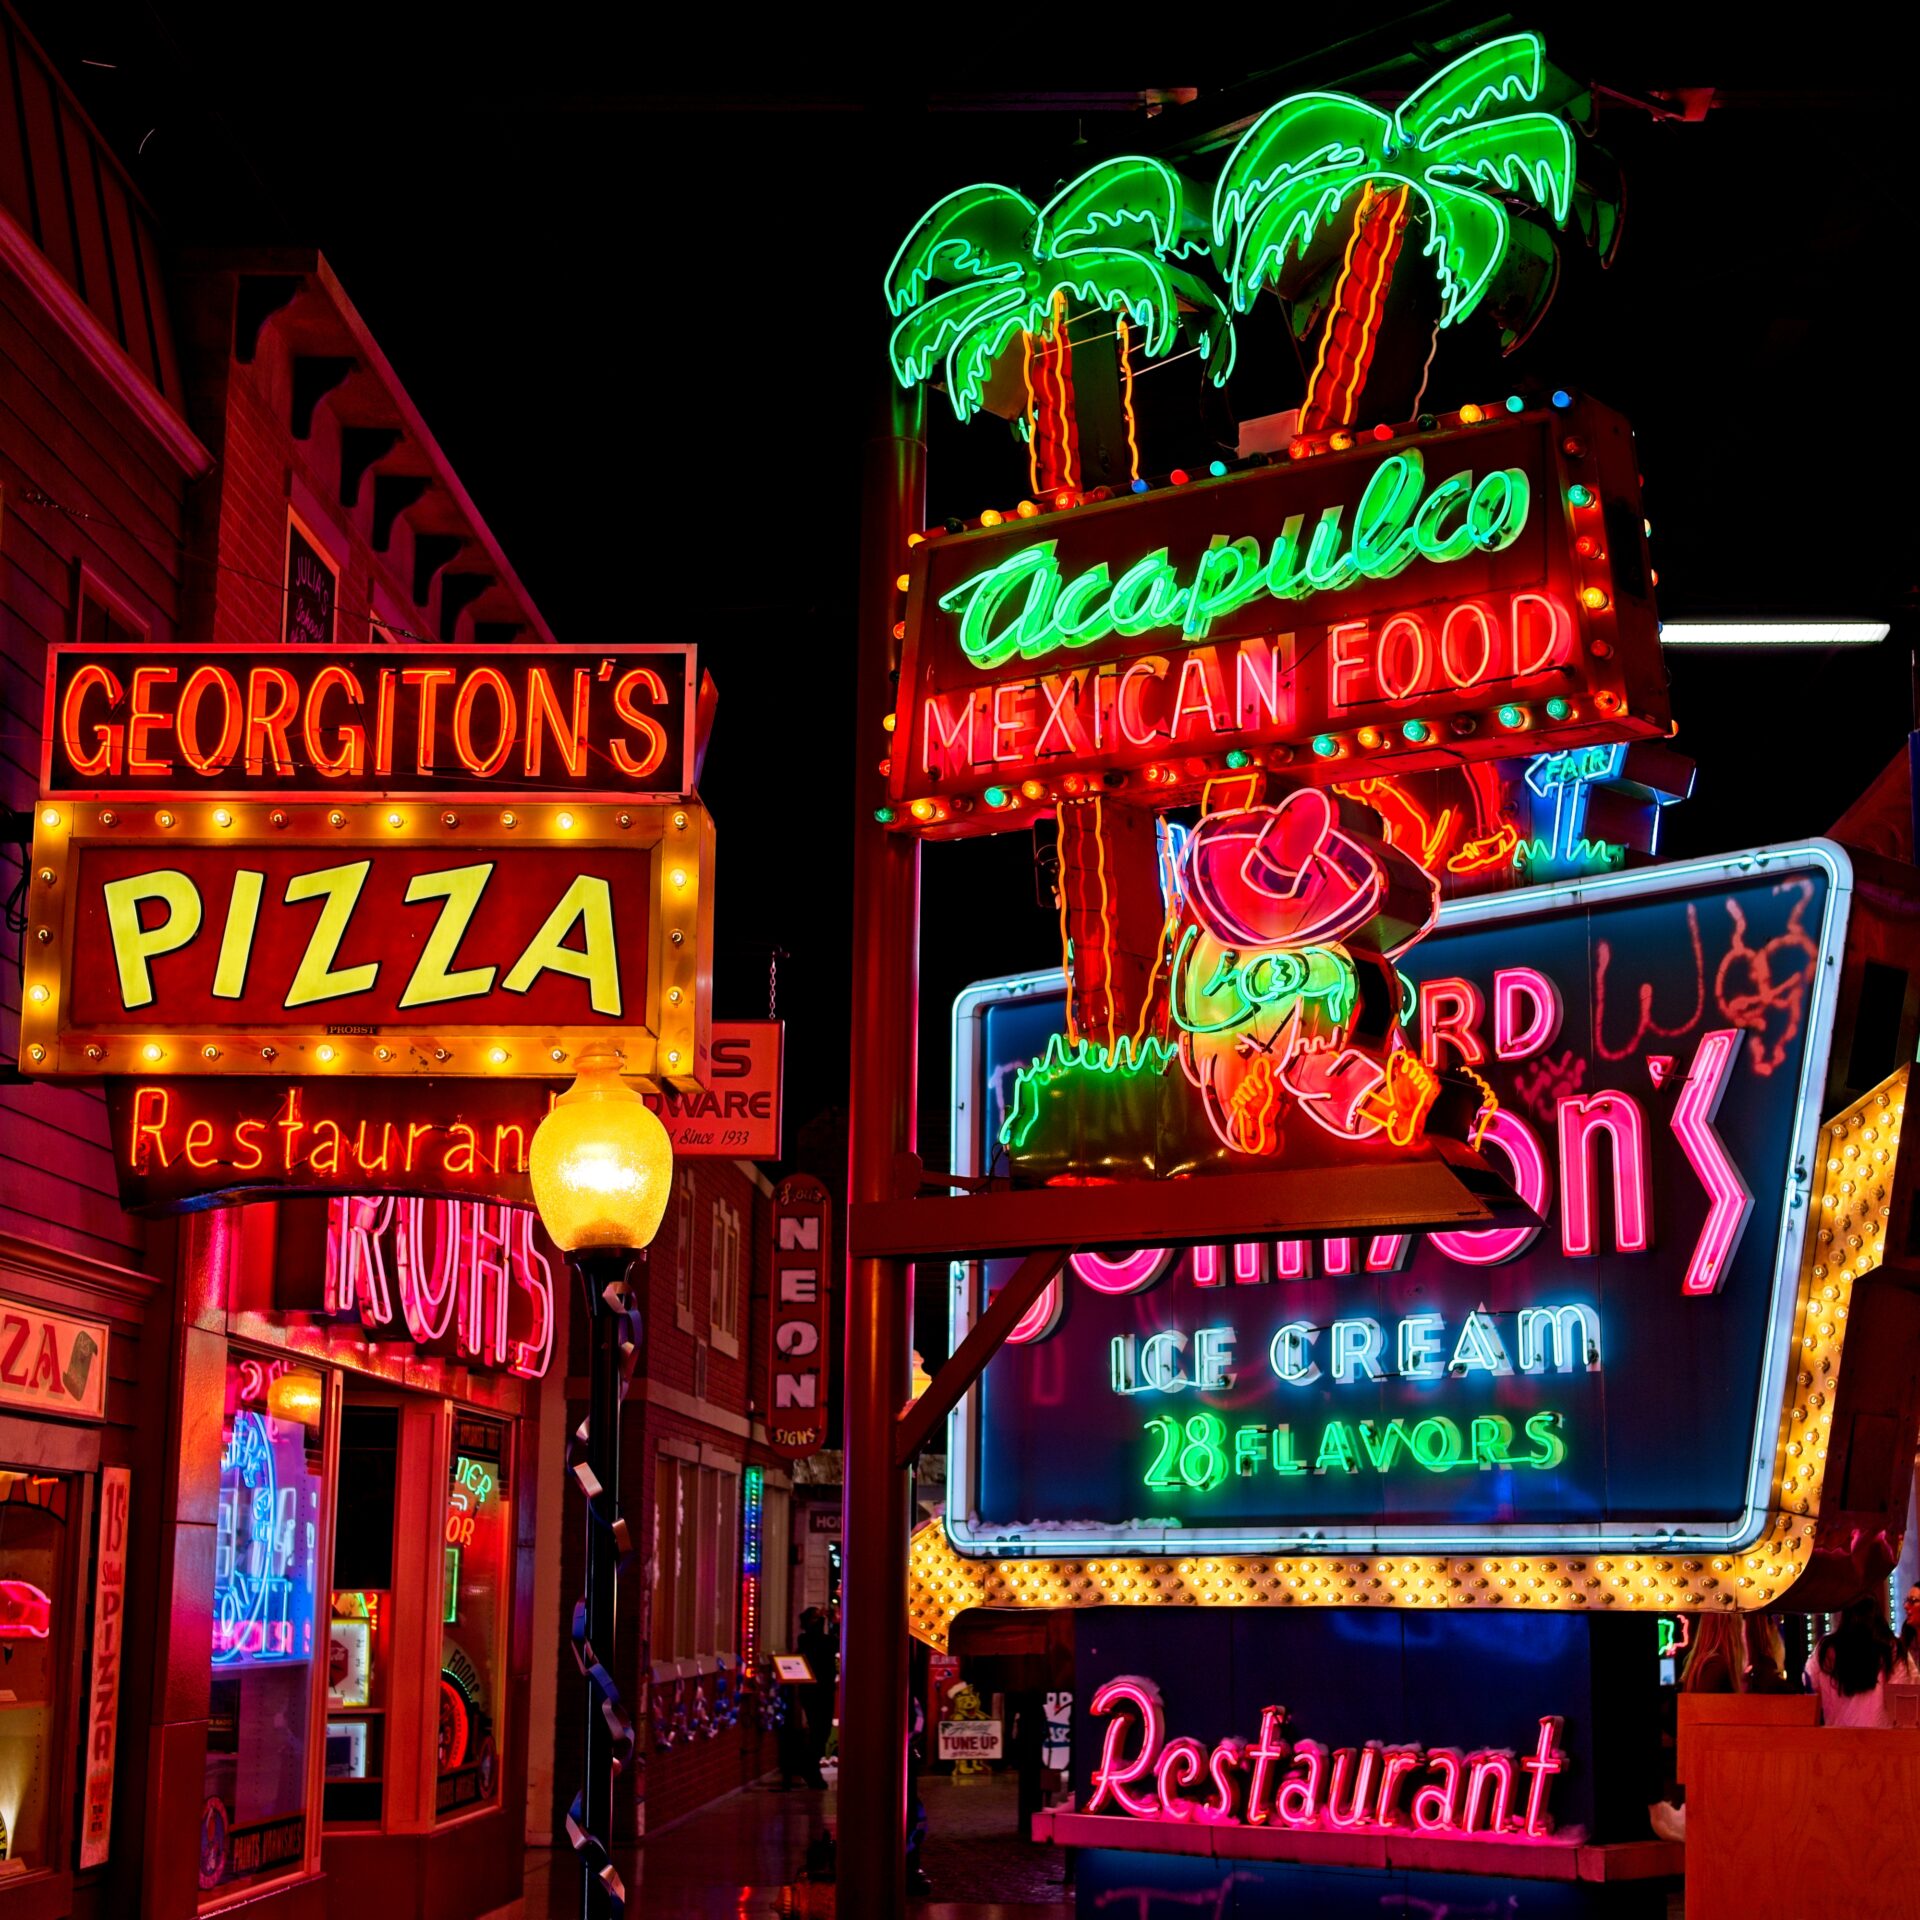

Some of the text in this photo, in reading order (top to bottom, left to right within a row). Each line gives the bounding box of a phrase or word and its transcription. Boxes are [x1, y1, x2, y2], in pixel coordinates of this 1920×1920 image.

[940, 449, 1530, 671] Acapulco
[62, 659, 669, 777] GEORGITON'S
[921, 591, 1573, 781] MEXICAN FOOD
[102, 860, 624, 1017] PIZZA
[329, 1025, 377, 1034] PROBST
[131, 1087, 538, 1174] Restauran
[678, 1127, 715, 1145] Since
[720, 1129, 750, 1145] 1933
[776, 1217, 819, 1408] NEON
[1110, 1302, 1601, 1396] ICE CREAM
[775, 1427, 816, 1446] SIGNS
[1142, 1411, 1567, 1492] 28 FLAVORS
[95, 1591, 121, 1761] PIZZA
[942, 1736, 999, 1750] TUNE UP
[1086, 1679, 1567, 1838] Restaurant
